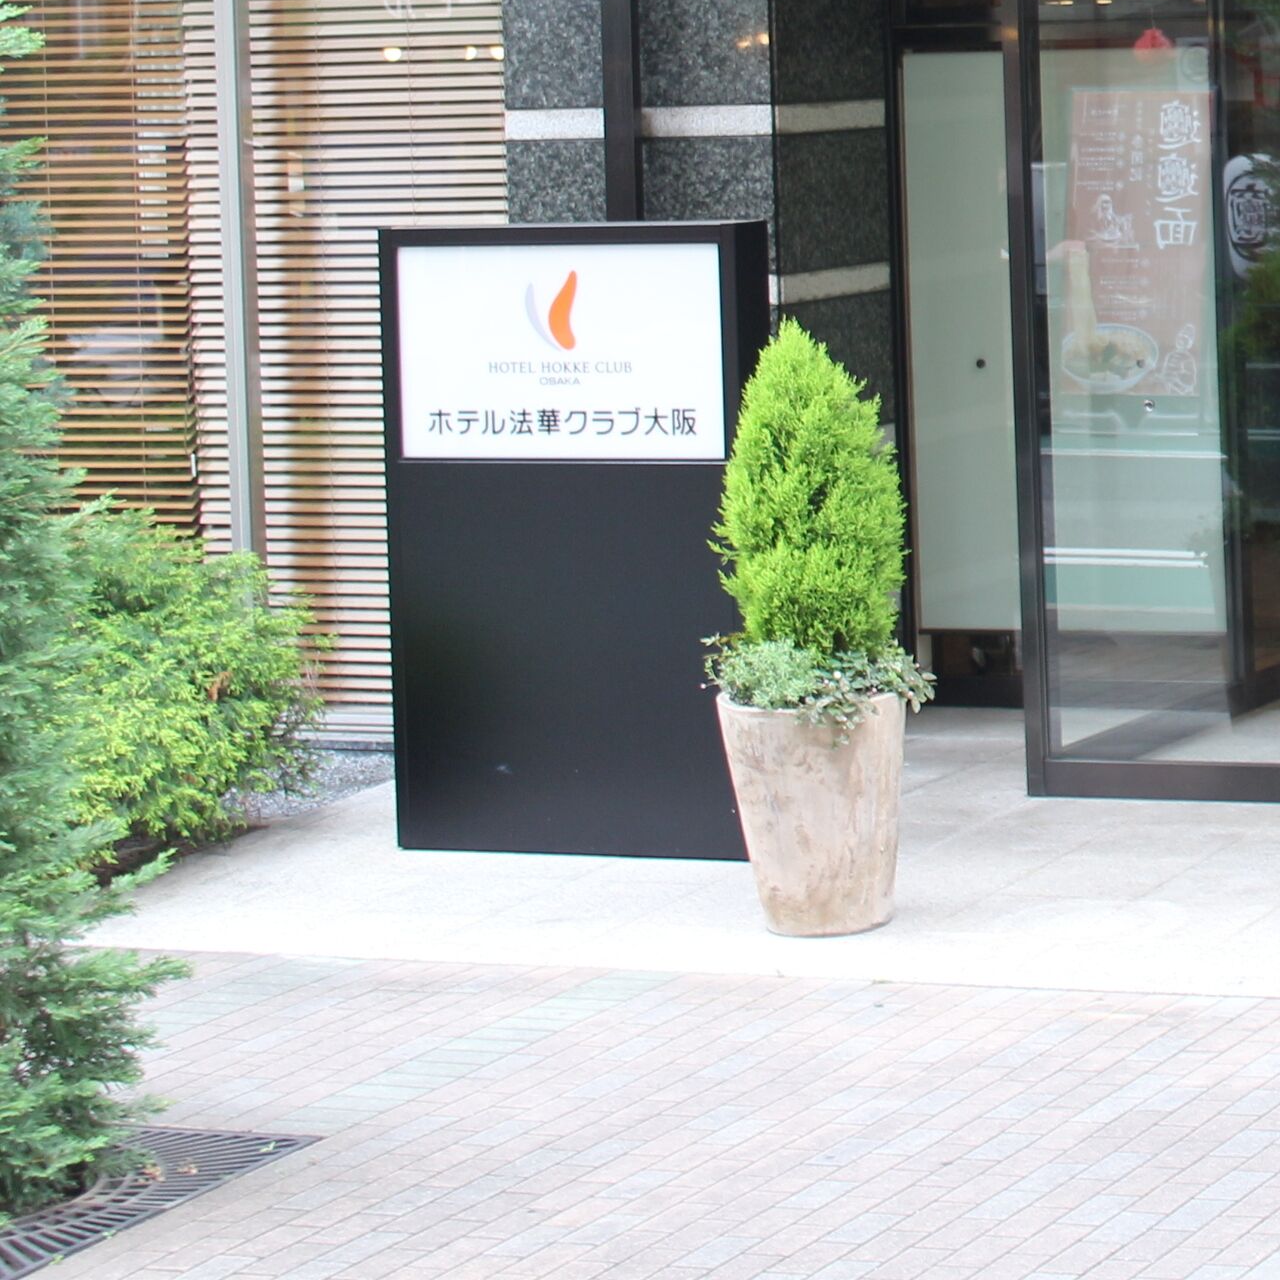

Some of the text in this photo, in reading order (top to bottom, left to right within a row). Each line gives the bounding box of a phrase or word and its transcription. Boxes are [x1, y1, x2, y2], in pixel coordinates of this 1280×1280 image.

[488, 361, 633, 374] HOTEL HOKKE CLUB
[539, 377, 581, 386] OSAKA
[428, 407, 698, 436] ホテル法華クラブ大阪
